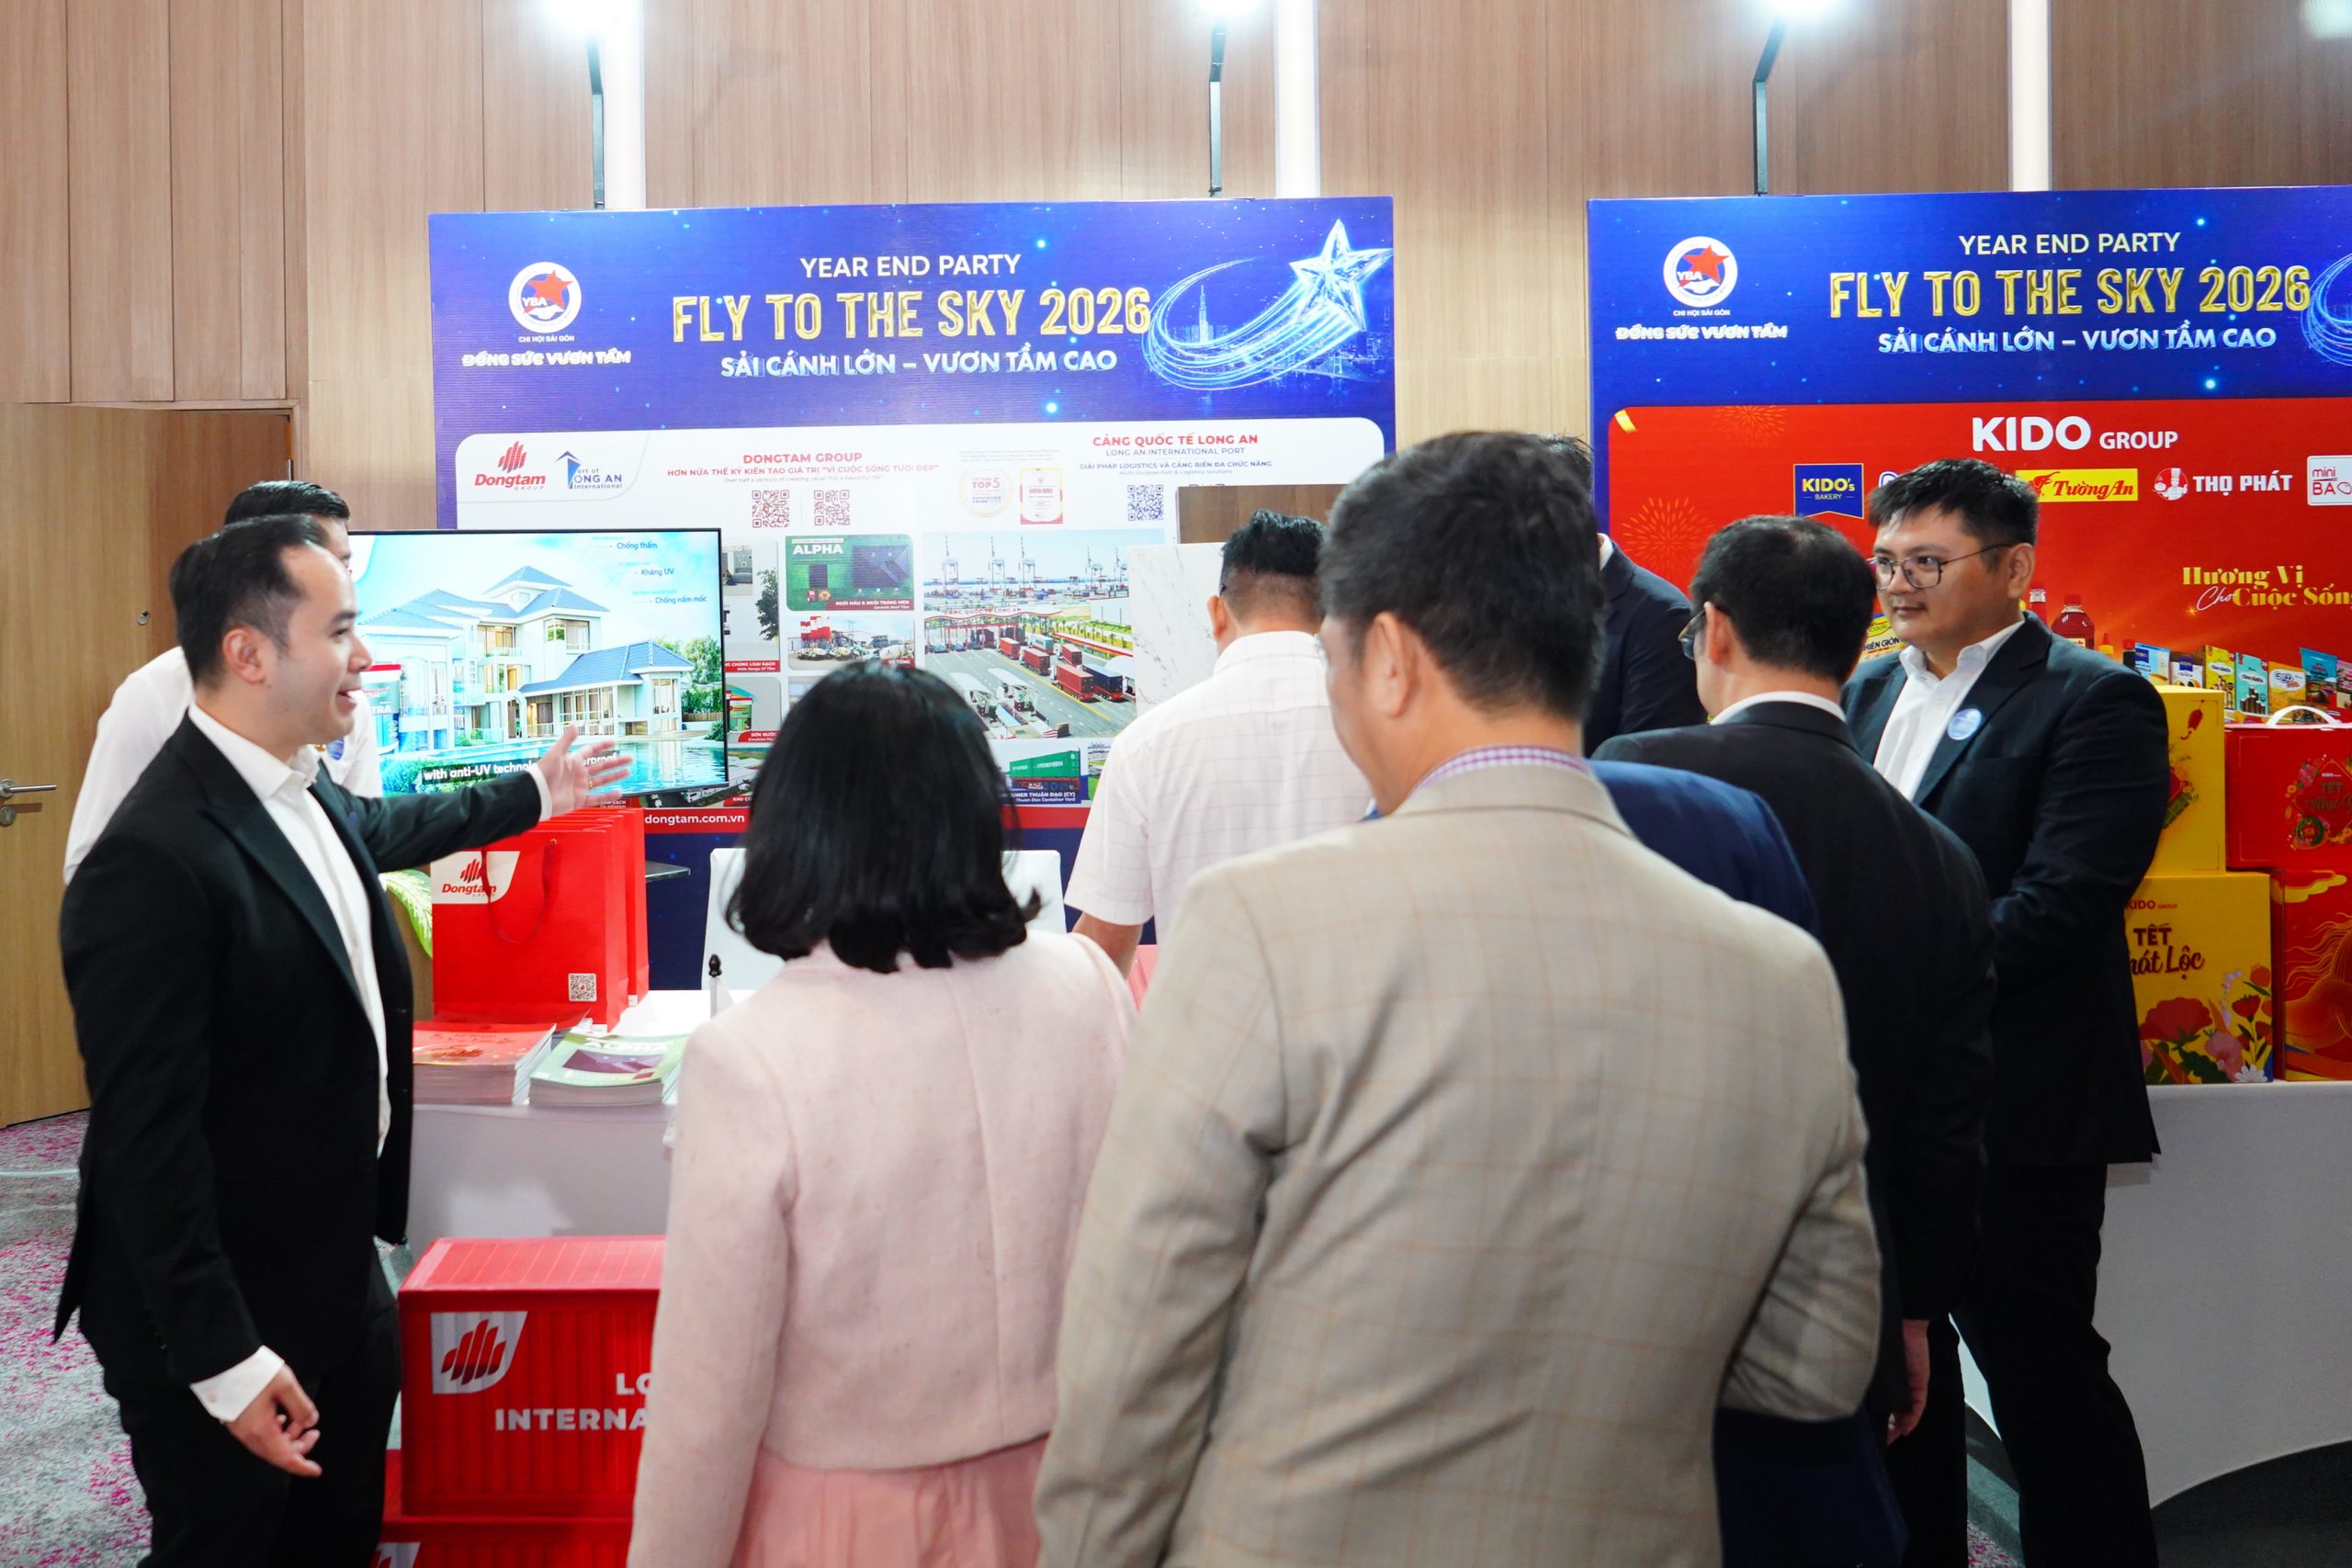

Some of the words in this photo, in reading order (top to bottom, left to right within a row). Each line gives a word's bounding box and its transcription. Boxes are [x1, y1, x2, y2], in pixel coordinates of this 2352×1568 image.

[1959, 234, 2028, 255] YEAR
[2036, 233, 2090, 254] END
[2098, 232, 2181, 254] PARTY
[800, 257, 868, 278] YEAR
[876, 255, 930, 276] END
[939, 254, 1022, 275] PARTY
[1676, 271, 1702, 281] YBA
[1829, 271, 1909, 318] FLY
[1924, 270, 1981, 317] TO
[1996, 268, 2083, 316] THE
[2097, 266, 2185, 314] SKY
[2199, 265, 2311, 313] 2026
[521, 297, 548, 307] YBA
[673, 294, 752, 344] FLY
[766, 293, 822, 341] TO
[837, 290, 923, 339] THE
[937, 288, 1026, 337] SKY
[1039, 287, 1151, 336] 2026
[1878, 327, 1917, 354] SẢI
[1924, 327, 1996, 353] CÁNH
[2003, 325, 2055, 352] LỚN
[2082, 329, 2158, 351] VƯƠN
[2165, 320, 2216, 349] TẦM
[2222, 327, 2277, 348] CAO
[721, 350, 761, 378] SẢI
[766, 349, 838, 377] CÁNH
[844, 348, 897, 375] LỚN
[923, 350, 1000, 373] VƯƠN
[1006, 342, 1057, 372] TẦM
[1064, 349, 1118, 371] CAO
[1092, 434, 1131, 446] CẢNG
[1135, 433, 1174, 447] QUỐC
[1178, 432, 1194, 445] TẾ
[1198, 435, 1235, 445] LONG
[1238, 434, 1258, 444] AN
[1972, 415, 2091, 452] KIDO
[2099, 431, 2178, 450] GROUP
[743, 454, 811, 464] DONGTAM
[815, 452, 862, 463] GROUP
[1148, 447, 1218, 456] INTERNATIONAL
[605, 474, 622, 483] AN
[2312, 466, 2336, 477] mini
[474, 473, 546, 489] Dongtam
[993, 477, 1001, 489] 5
[2193, 474, 2233, 496] THỌ
[2240, 469, 2293, 491] PHÁT
[793, 544, 843, 555] ALPHA
[2182, 566, 2270, 591] Hương
[2277, 565, 2304, 589] Vị
[2196, 585, 2236, 611] Cho
[2233, 587, 2297, 611] Cuộc
[2303, 582, 2352, 611] Sốn
[424, 768, 447, 781] with
[449, 765, 492, 779] anti-UV
[645, 813, 745, 825] dongtam.com.vn
[2126, 899, 2156, 910] KIDO
[2133, 922, 2172, 946] TẾT
[2165, 944, 2205, 981] Lộc
